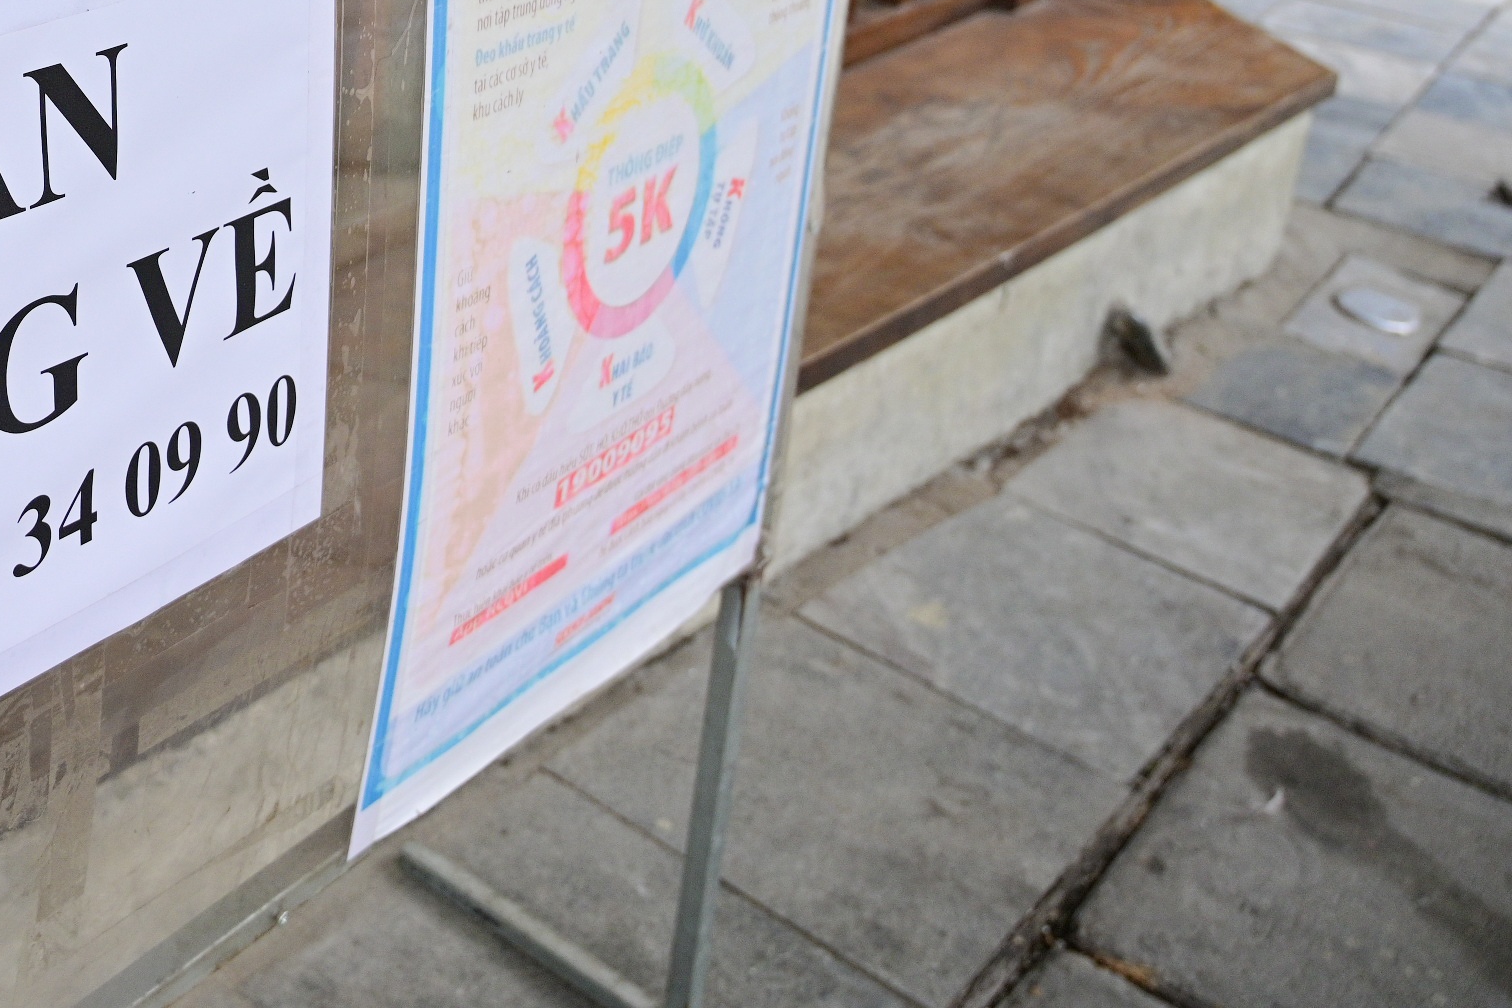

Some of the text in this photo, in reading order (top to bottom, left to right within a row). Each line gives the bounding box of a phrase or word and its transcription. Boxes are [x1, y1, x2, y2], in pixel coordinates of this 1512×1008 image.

[475, 48, 496, 67] Đeo
[526, 26, 555, 48] trang
[477, 14, 492, 32] nơi
[512, 0, 537, 20] trung
[593, 19, 630, 82] TRANG
[472, 103, 491, 121] khu
[492, 91, 513, 113] cách
[603, 163, 679, 265] 5K
[127, 168, 296, 367] VỀ
[13, 468, 97, 578] 34
[125, 421, 202, 518] 09
[227, 374, 297, 474] 90
[559, 411, 673, 501] 19009095
